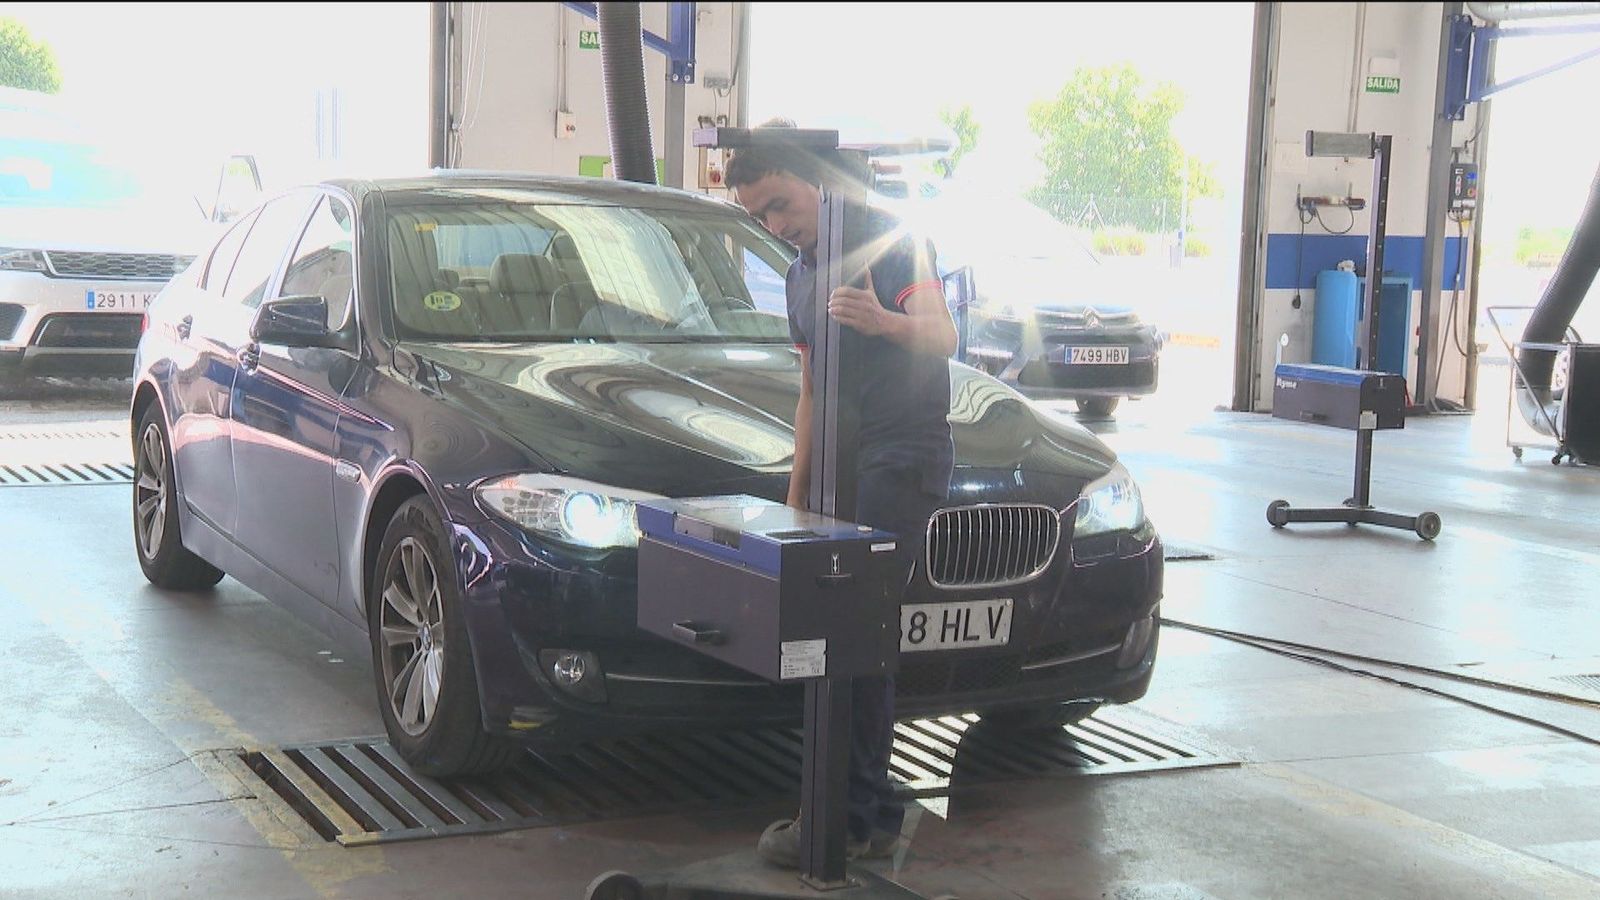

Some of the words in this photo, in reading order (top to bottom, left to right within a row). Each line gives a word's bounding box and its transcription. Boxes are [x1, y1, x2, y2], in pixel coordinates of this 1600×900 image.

[1368, 77, 1398, 89] SALIDA
[97, 294, 136, 308] 2911
[144, 294, 156, 308] K
[1073, 348, 1102, 362] 7499
[1106, 348, 1127, 362] HBV
[941, 606, 1004, 643] HLV
